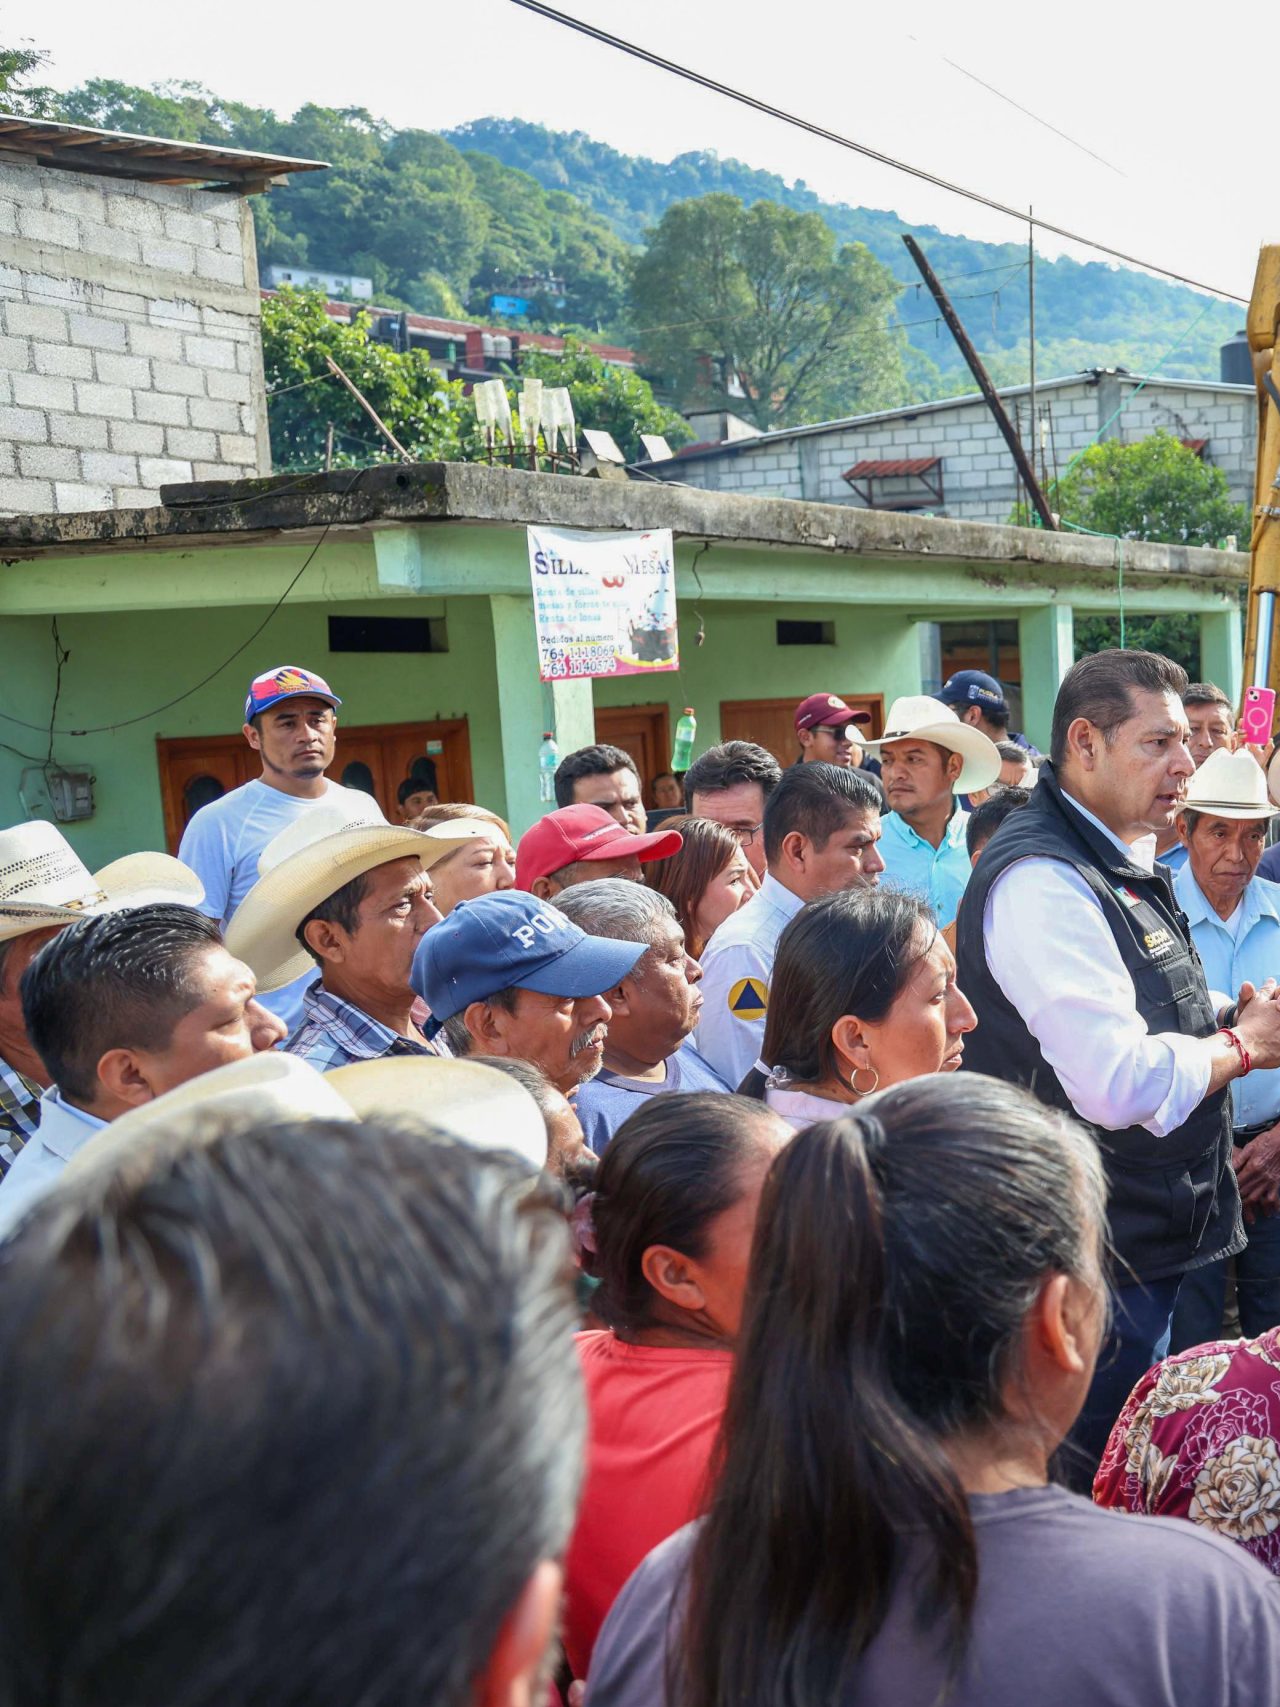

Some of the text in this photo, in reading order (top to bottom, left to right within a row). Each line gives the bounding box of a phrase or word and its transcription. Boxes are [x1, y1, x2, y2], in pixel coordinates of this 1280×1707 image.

[534, 551, 590, 575] SILL
[542, 648, 564, 660] 764
[570, 645, 615, 658] 1118069
[544, 661, 565, 675] 764
